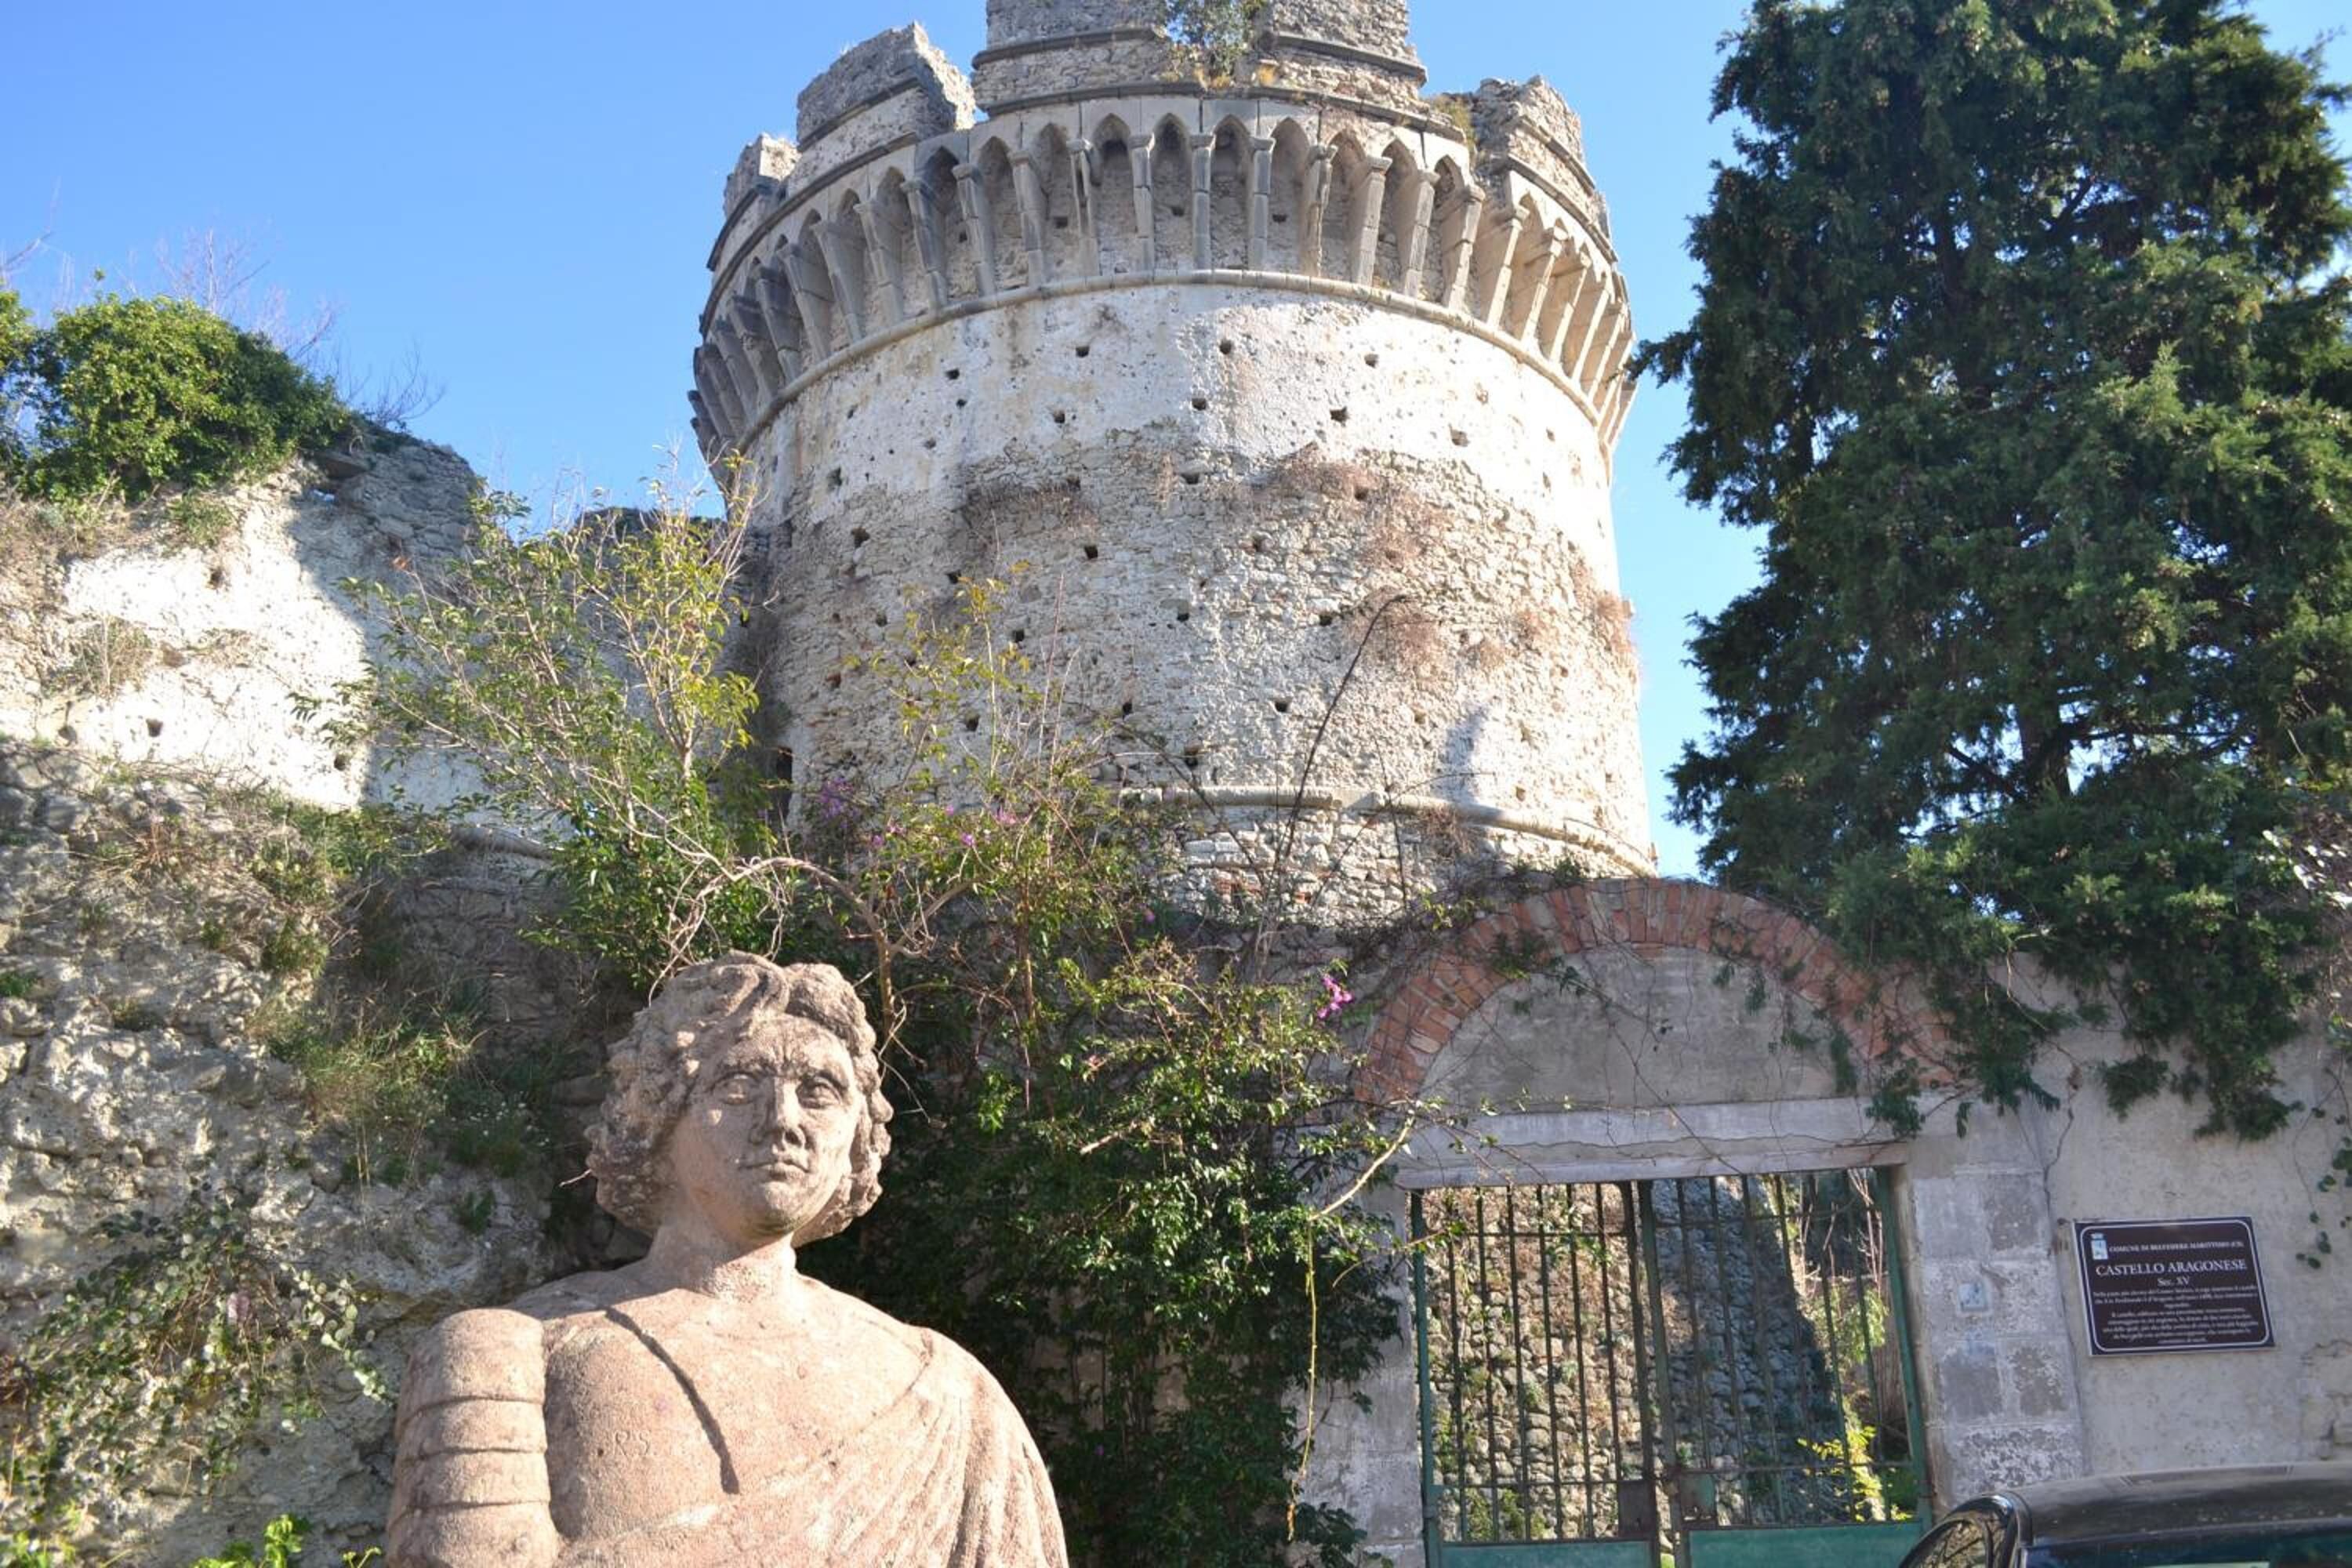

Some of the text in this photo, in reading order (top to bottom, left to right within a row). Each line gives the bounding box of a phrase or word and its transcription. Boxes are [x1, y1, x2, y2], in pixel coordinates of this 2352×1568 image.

[2096, 1258, 2248, 1276] CASTELLO ARAGONESE
[2176, 1276, 2190, 1286] XV
